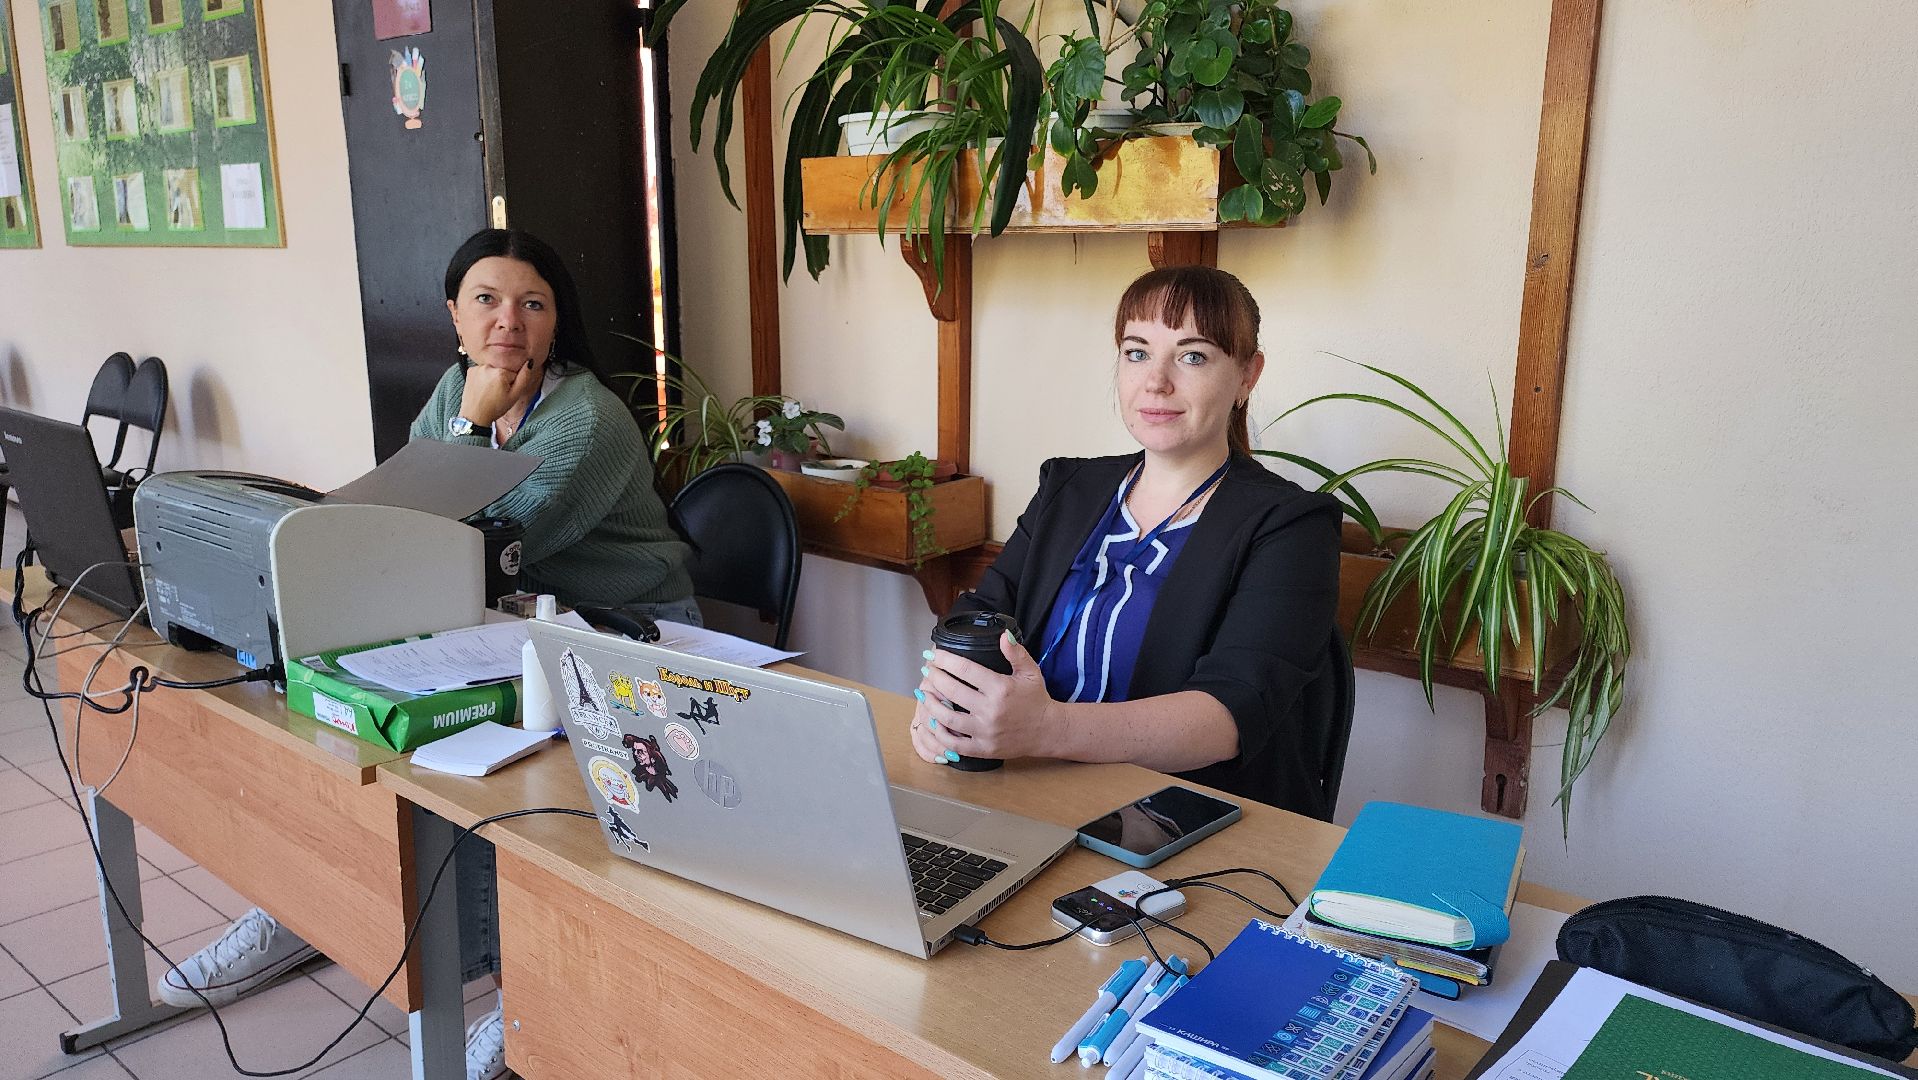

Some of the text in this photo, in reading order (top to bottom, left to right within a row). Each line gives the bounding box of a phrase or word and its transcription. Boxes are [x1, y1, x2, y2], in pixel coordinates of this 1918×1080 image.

[433, 701, 496, 729] PREMIUM
[703, 759, 737, 809] hp
[1176, 1028, 1220, 1049] КАШИРА
